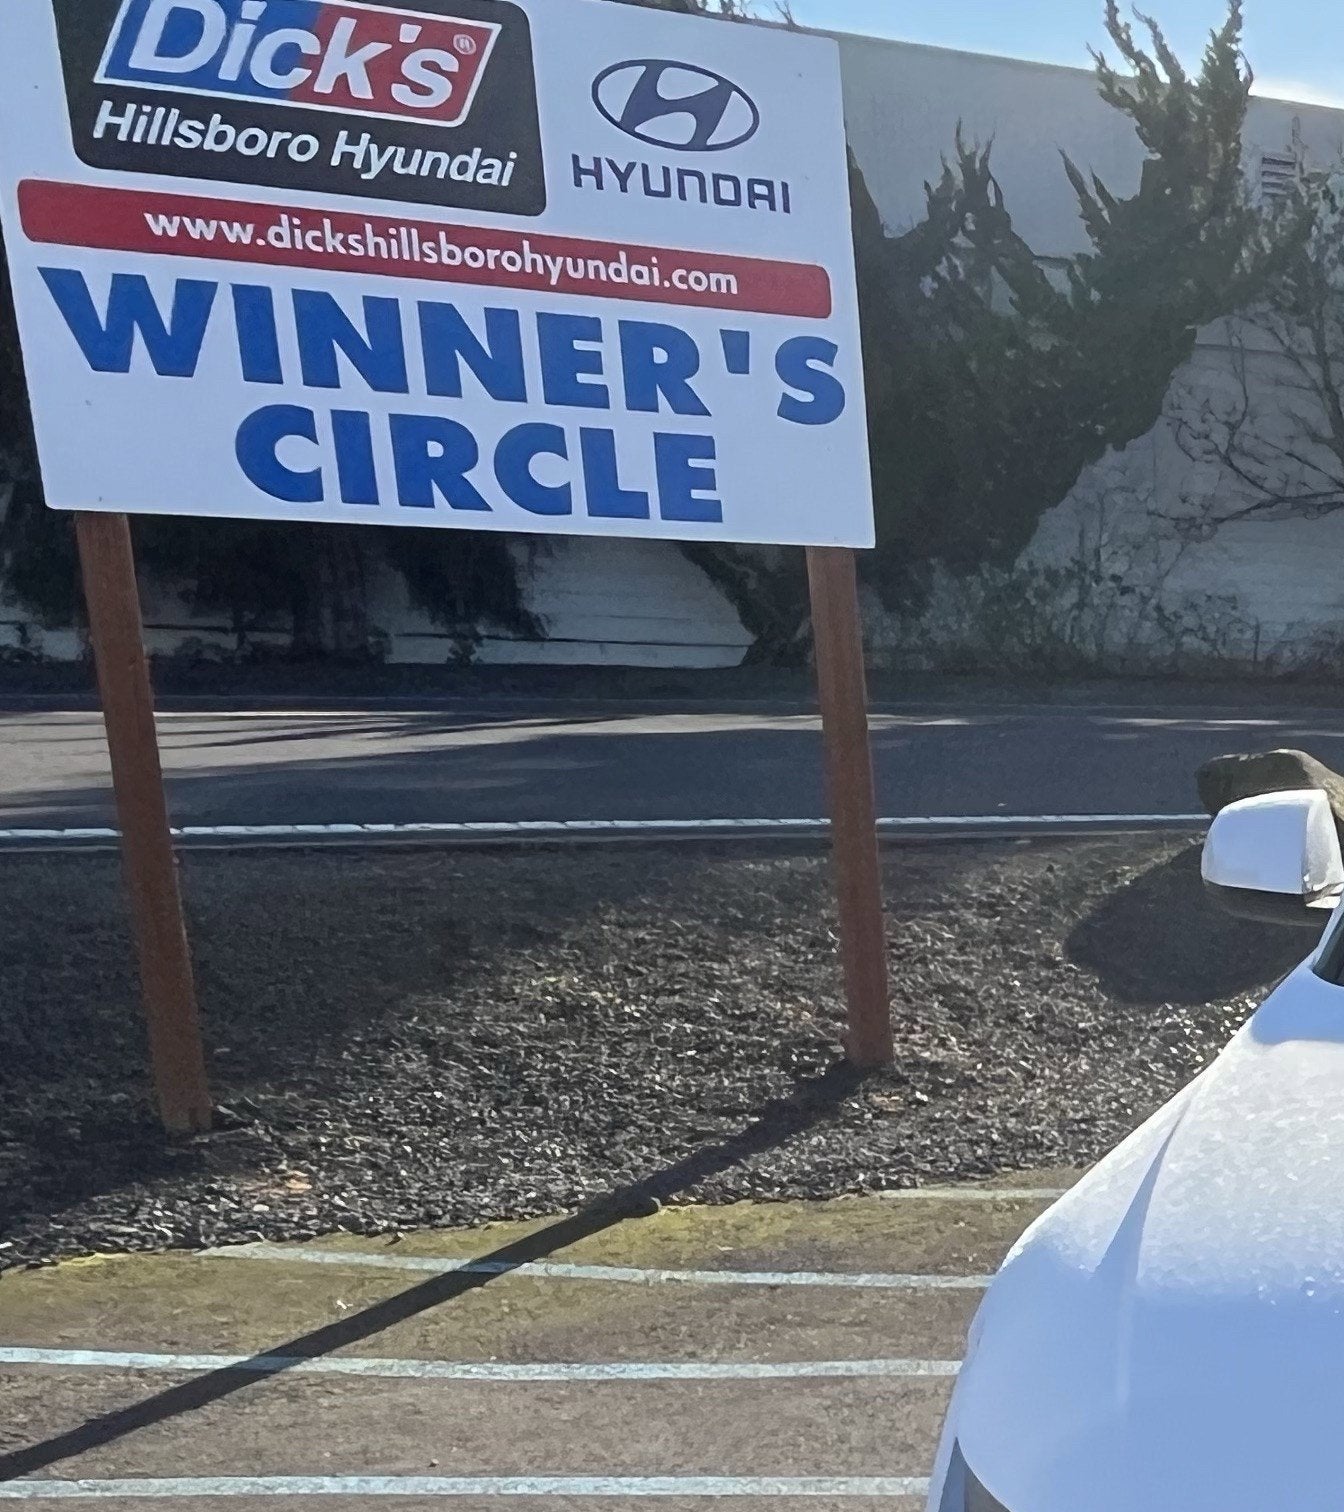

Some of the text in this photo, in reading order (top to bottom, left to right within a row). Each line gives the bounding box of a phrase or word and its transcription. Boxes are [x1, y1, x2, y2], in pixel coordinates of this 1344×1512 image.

[128, 0, 460, 108] Dick's
[93, 100, 518, 187] Hillsboro Hyundai
[572, 155, 792, 215] HYUNDAI
[143, 209, 739, 296] www.dickshillsborohyundai.com
[37, 266, 846, 426] WINNER'S
[235, 404, 724, 523] CIRCLE
